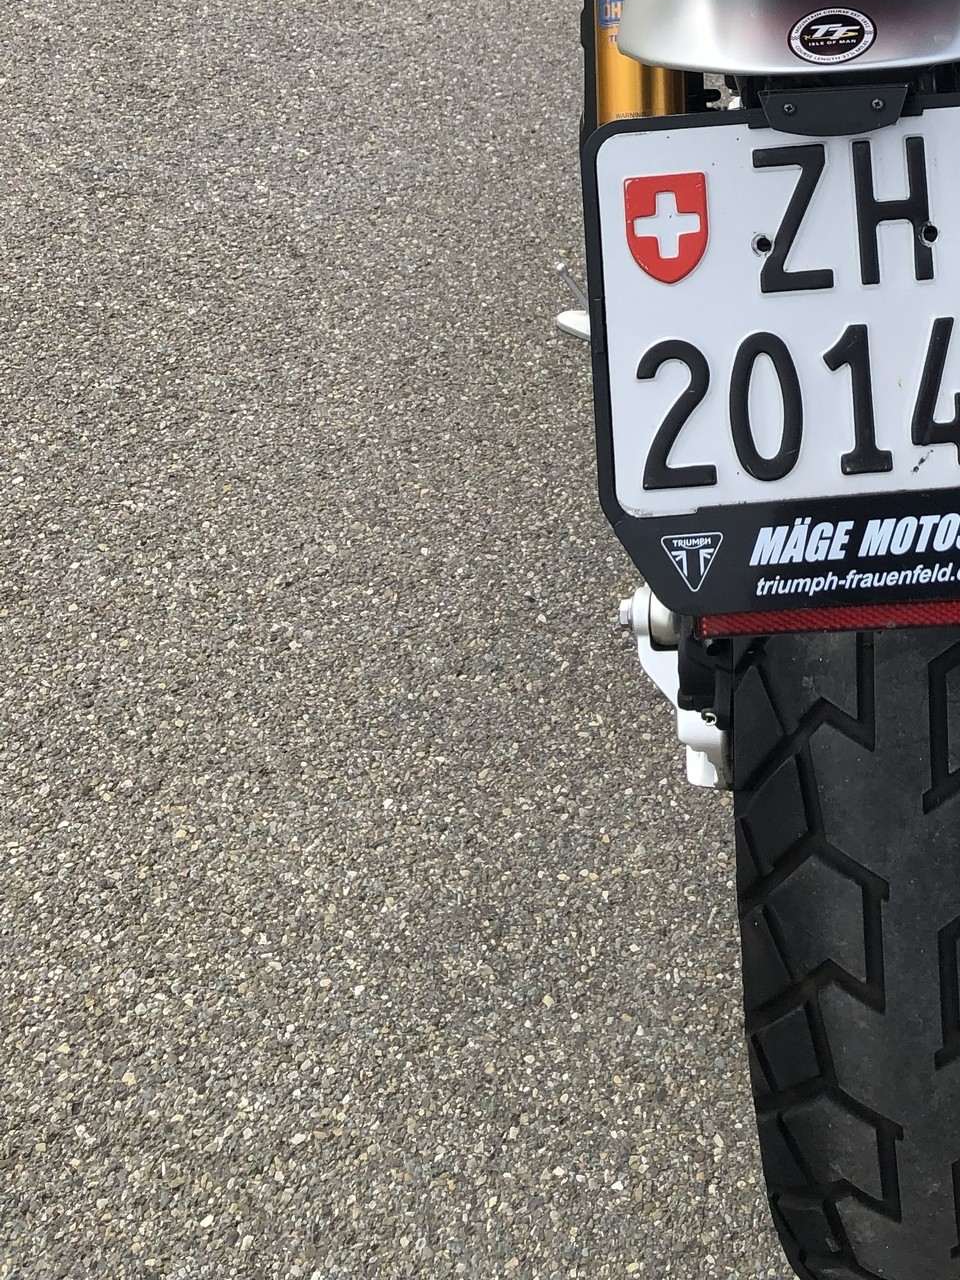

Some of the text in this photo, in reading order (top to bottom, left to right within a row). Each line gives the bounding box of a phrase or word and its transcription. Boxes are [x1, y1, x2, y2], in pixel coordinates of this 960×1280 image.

[795, 12, 822, 34] MOUNTAIN
[810, 23, 860, 40] TT
[615, 111, 647, 119] WARNING
[751, 136, 936, 294] ZH
[672, 536, 712, 549] TRIUMPH
[749, 516, 854, 566] MÄGE
